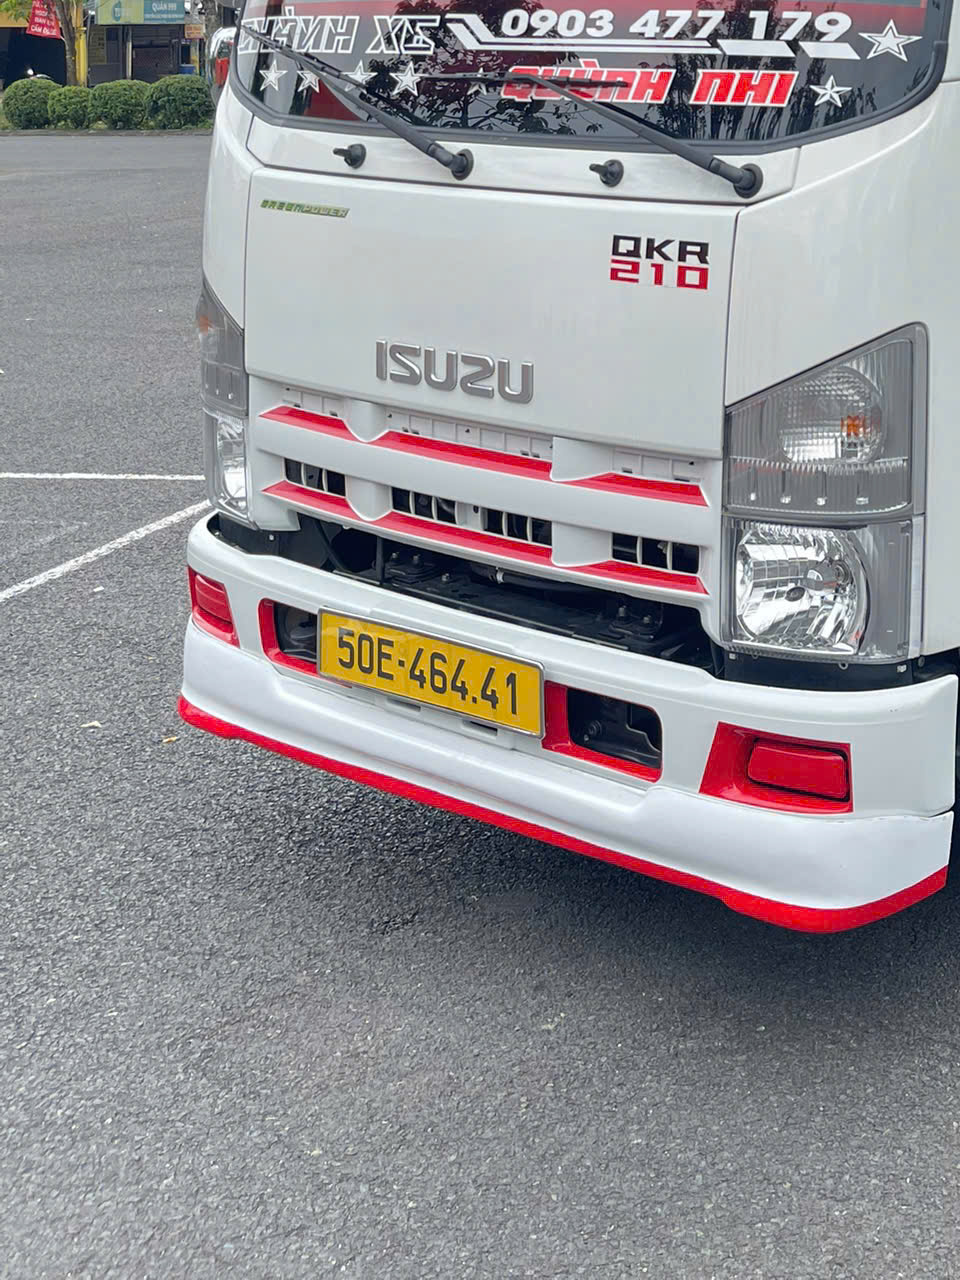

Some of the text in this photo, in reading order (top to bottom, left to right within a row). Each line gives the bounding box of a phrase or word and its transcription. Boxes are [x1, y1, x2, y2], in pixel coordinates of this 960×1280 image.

[366, 14, 441, 55] XE
[500, 8, 852, 42] 0903 477 179
[612, 234, 709, 265] QKR
[610, 258, 709, 290] 210
[376, 338, 534, 405] ISUZU
[337, 626, 518, 716] 50E-464.41
